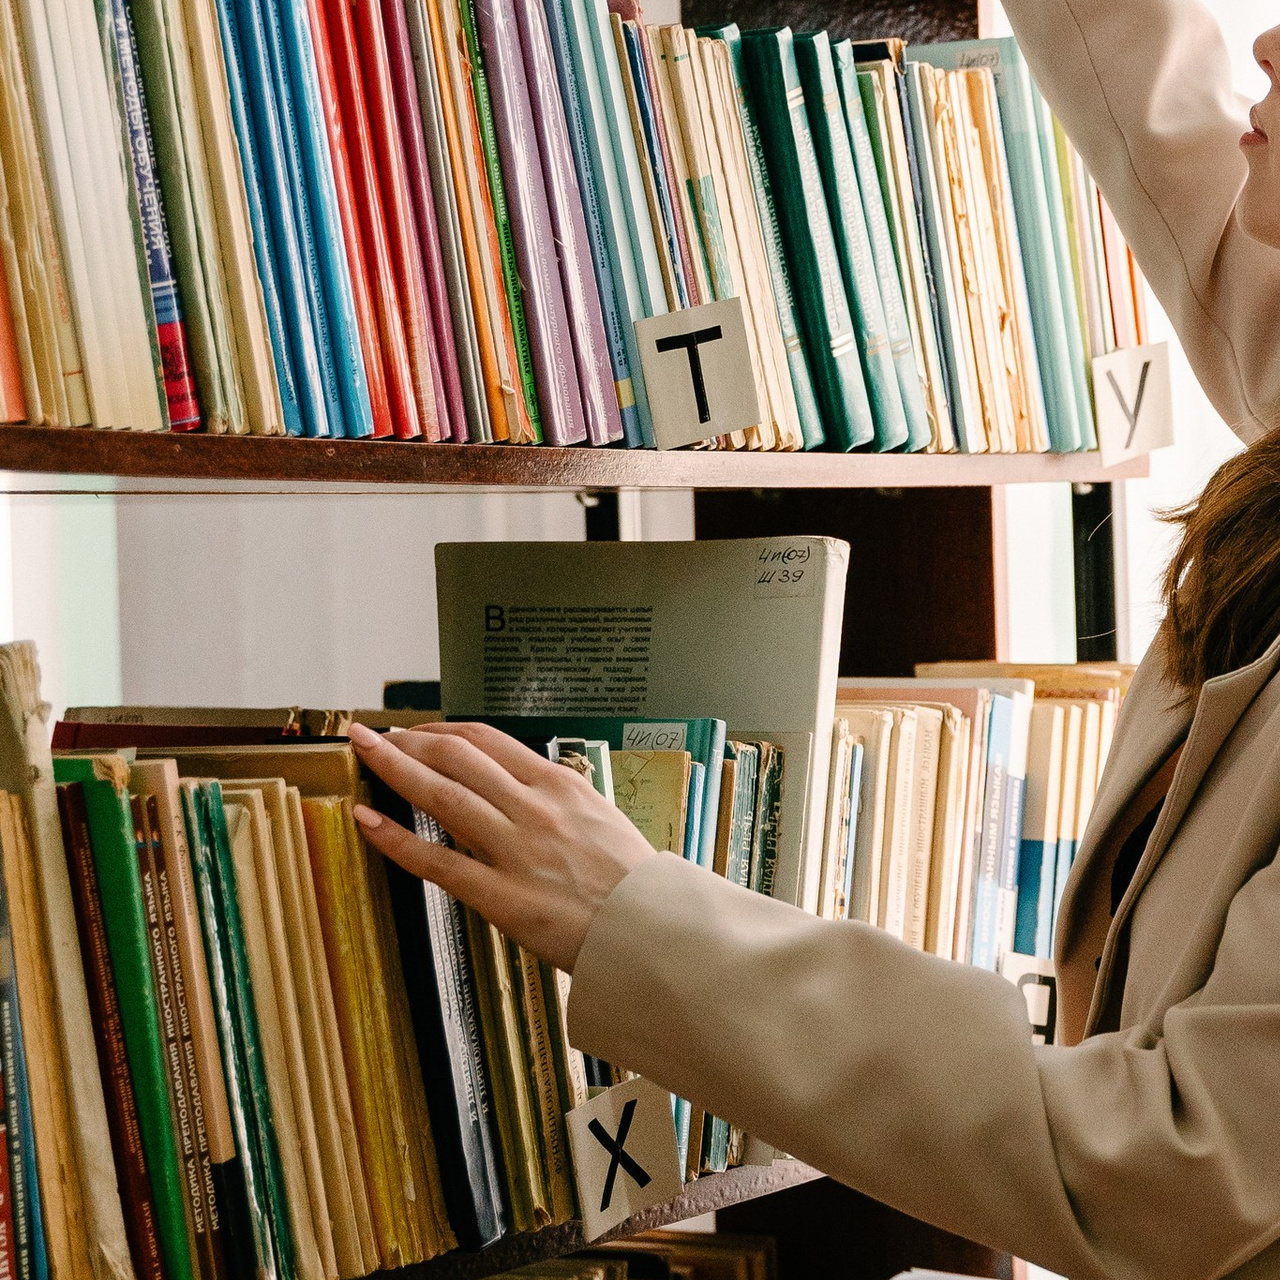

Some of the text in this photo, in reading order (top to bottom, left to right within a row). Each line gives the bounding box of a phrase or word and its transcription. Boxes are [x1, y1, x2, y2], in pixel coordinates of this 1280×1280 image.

[116, 38, 143, 131] МЕТОДЫ
[132, 134, 164, 250] ОБУЧЕНИЯ
[574, 106, 605, 268] Методика обучения иностранному
[740, 106, 762, 180] ОБУЧЕНИЯ
[802, 128, 820, 191] ЯЗЫКАМ
[477, 68, 531, 374] ИНТЕГРАТИВНОЕ ОБУЧЕНИЕ ИНОЯЗЫЧНОЙ ГРАММАТИКЕ
[751, 124, 795, 307] ИНОСТРАННЫМ ЯЗЫКАМ
[307, 248, 328, 343] иностранным
[323, 349, 337, 404] языкам
[539, 256, 561, 353] поликультурного
[556, 356, 574, 428] образования
[856, 275, 876, 332] ОСНОВЫ
[655, 325, 723, 424] Т
[1106, 360, 1150, 448] У
[779, 569, 804, 584] 39
[921, 729, 933, 771] ЯЗЫКАМ
[741, 809, 753, 850] РЕЧЬ
[917, 777, 929, 852] ИНОСТРАННЫМ
[978, 822, 999, 942] ИНОСТРАННЫМ
[989, 752, 1004, 819] ЯЗЫКАМ
[913, 857, 923, 909] ОБУЧЕНИЕ
[1, 1001, 16, 1095] ИНОСТРАННЫЙ
[142, 870, 205, 1232] МЕТОДИКА ПРЕПОДАВАНИЯ ИНОСТРАННОГО ЯЗЫКА
[158, 869, 220, 1230] МЕТОДИКА ПРЕПОДАВАНИЯ ИНОСТРАННОГО ЯЗЫКА
[463, 983, 486, 1094] ПРЕПОДАВАНИЕ
[9, 1099, 19, 1135] ЯЗЫК
[533, 1018, 564, 1174] ФУНКЦИОНАЛЬНЫЙ
[12, 1154, 27, 1245] ДОШКОЛЬНОМ
[588, 1099, 651, 1211] Х
